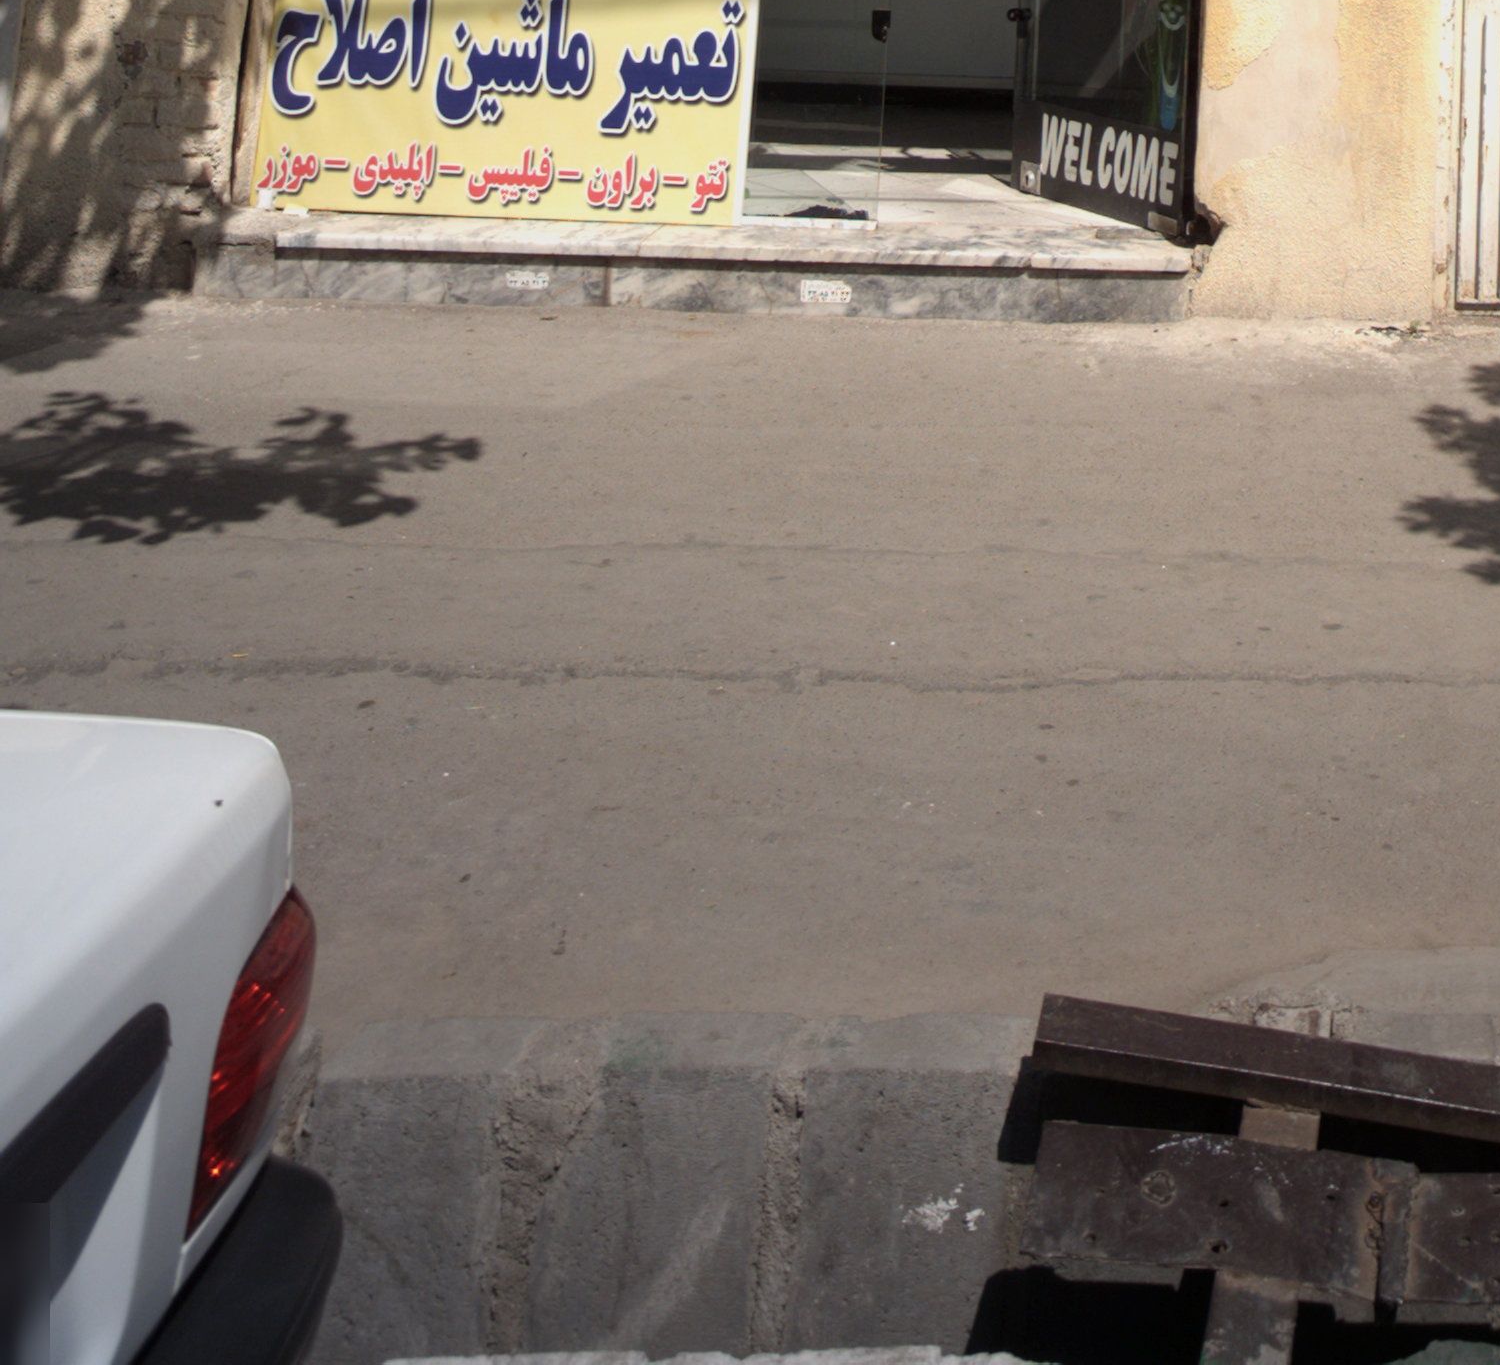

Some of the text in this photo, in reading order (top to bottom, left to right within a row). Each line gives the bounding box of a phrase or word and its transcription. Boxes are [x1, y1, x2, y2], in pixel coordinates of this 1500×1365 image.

[257, 145, 319, 192] موزر
[467, 146, 553, 204] فیلیپس
[586, 152, 657, 209] براون
